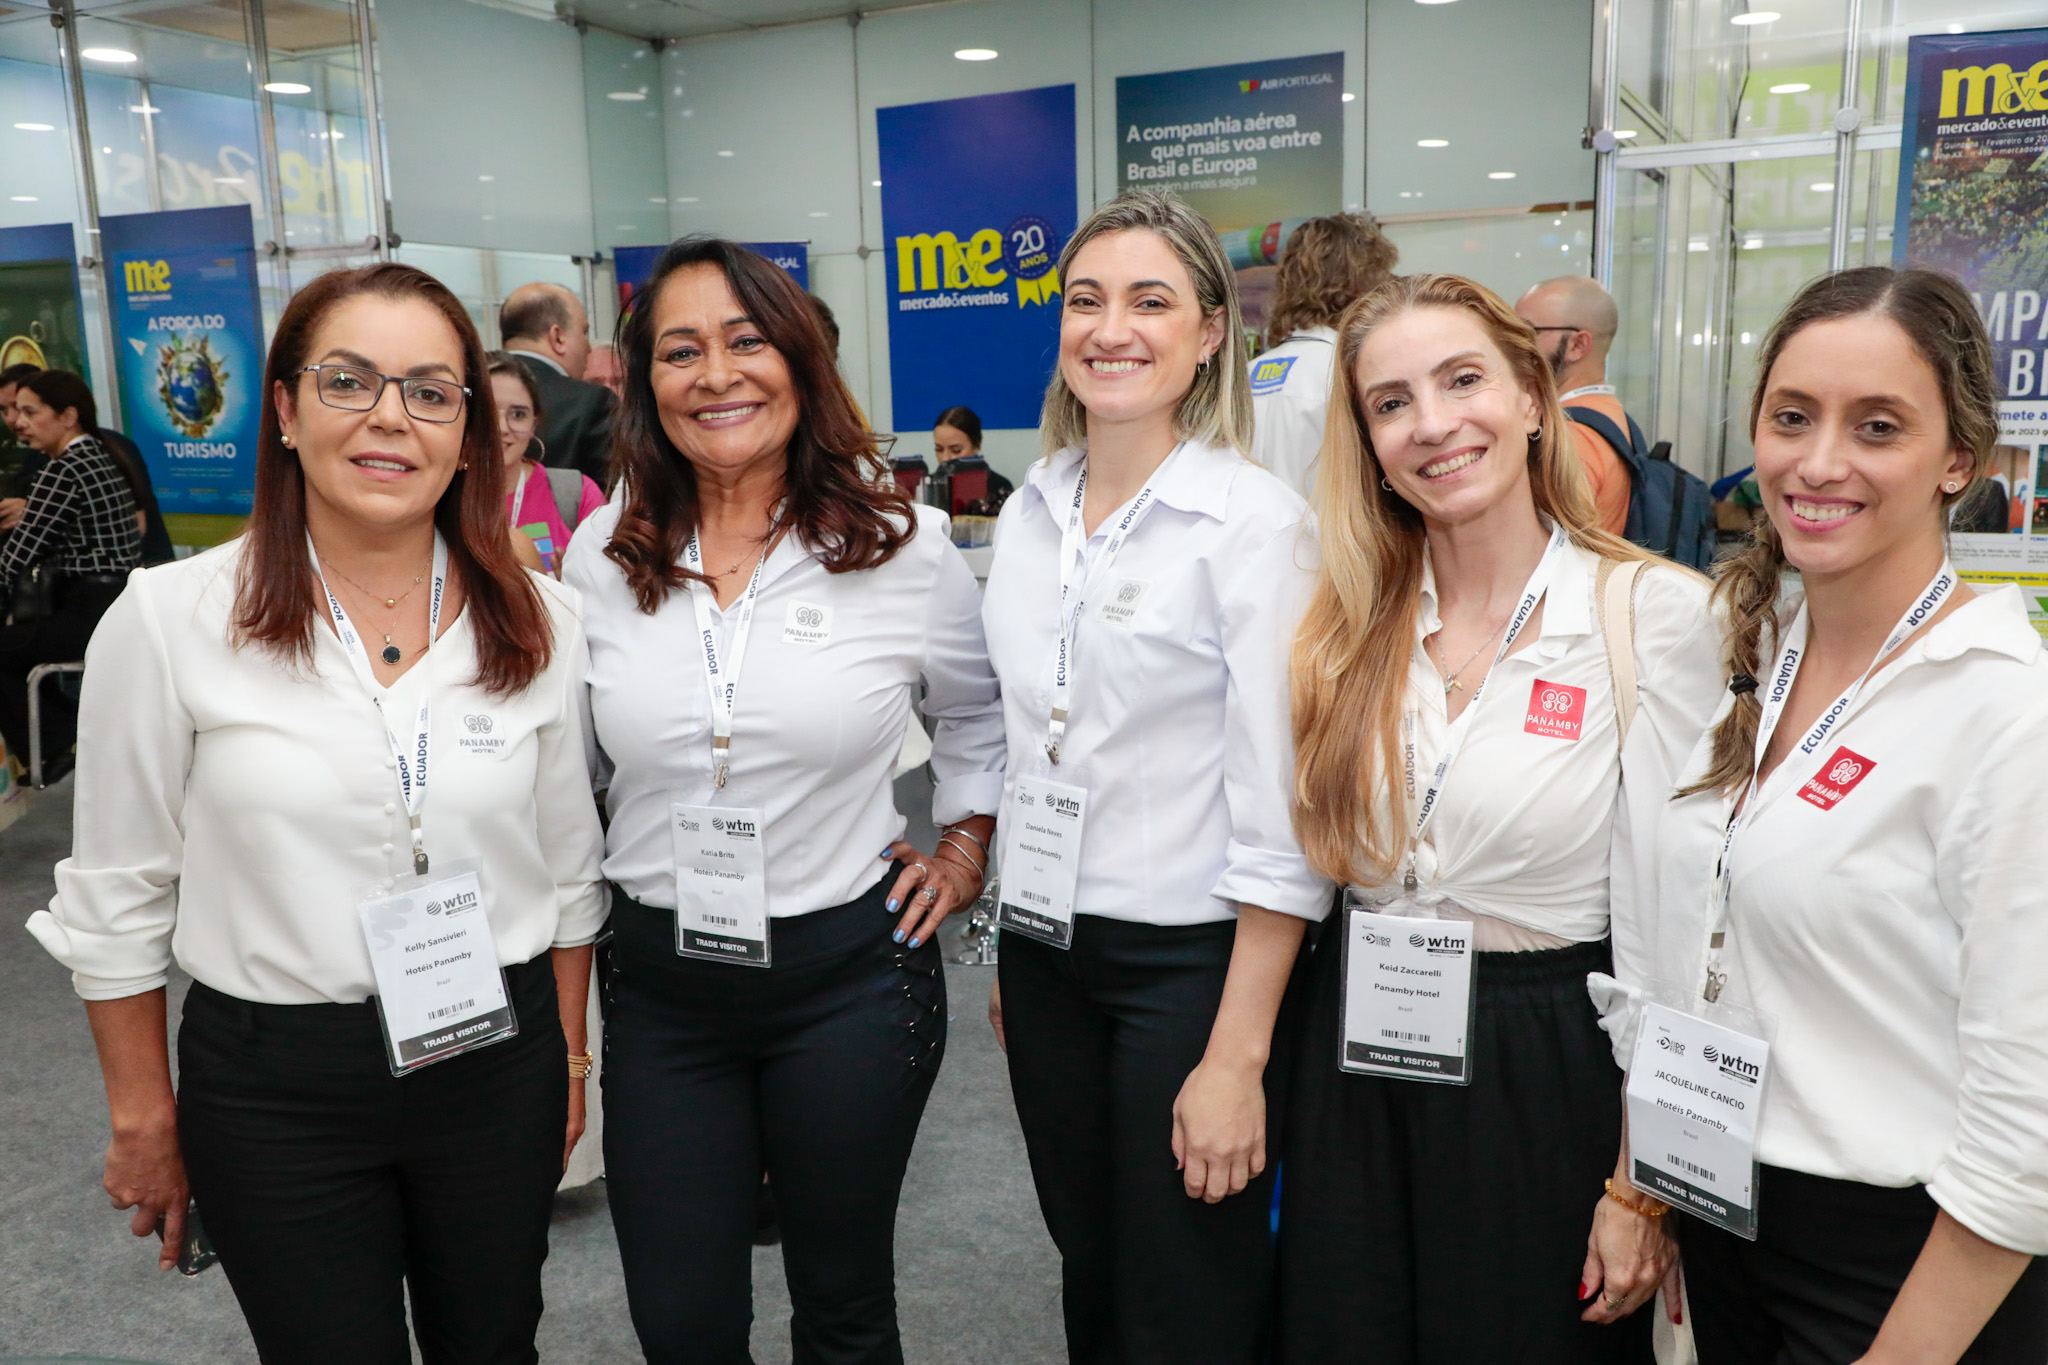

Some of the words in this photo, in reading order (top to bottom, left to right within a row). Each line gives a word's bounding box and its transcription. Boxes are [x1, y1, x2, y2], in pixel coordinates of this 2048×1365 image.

[1126, 125, 1141, 143] A
[1143, 116, 1241, 142] companhia
[1244, 112, 1297, 132] aérea
[1937, 114, 2048, 135] mercado&event
[1151, 144, 1184, 163] que
[1187, 138, 1230, 156] mais
[1232, 137, 1266, 151] voa
[1269, 130, 1322, 150] entre
[1986, 135, 2022, 147] Fevereiro
[2024, 135, 2034, 144] de
[1128, 161, 1176, 180] Brasil
[1178, 164, 1190, 176] e
[1192, 156, 1257, 176] Europa
[1183, 181, 1190, 190] a
[1191, 178, 1218, 189] mais
[1219, 176, 1257, 190] segura
[1012, 225, 1045, 258] 20
[896, 228, 1008, 292] m&e
[1019, 252, 1048, 270] ANOS
[900, 291, 1009, 311] mercado&eventos
[148, 317, 158, 331] A
[204, 314, 225, 329] DO
[2018, 428, 2040, 436] 2023
[164, 442, 237, 459] TURISMO
[1072, 469, 1087, 509] ECUADOR
[1118, 488, 1151, 531] ECUADOR
[432, 577, 443, 624] ECUADOR
[1907, 575, 1952, 627] ECUADOR
[1506, 593, 1536, 644] ECUADOR
[785, 627, 829, 640] PANAMBY
[703, 629, 719, 676] ECUADOR
[1057, 637, 1066, 686] ECUADOR
[1770, 649, 1799, 702] ECUADOR
[1527, 714, 1579, 731] PANAMBY
[1537, 727, 1564, 736] HOTEL
[1801, 698, 1849, 754] ECUADOR
[459, 739, 506, 747] PANAMBY
[416, 732, 428, 787] ECUADOR
[1405, 743, 1415, 800] ECUADOR
[1807, 779, 1843, 803] PANAMBY
[1807, 793, 1826, 805] HOTEL
[1057, 796, 1080, 812] wtm
[726, 818, 755, 832] wtm
[1025, 822, 1046, 834] Daniela
[1047, 828, 1062, 838] Neves
[718, 851, 735, 859] Brito
[1019, 843, 1037, 854] Hotéis
[1037, 847, 1062, 861] Panamby
[715, 870, 745, 881] Panamby
[443, 890, 476, 910] wtm
[1011, 912, 1030, 926] TRADE
[1031, 918, 1054, 933] VISITOR
[405, 941, 426, 954] Kelly
[428, 929, 467, 947] Sansivieri
[695, 937, 718, 949] TRADE
[720, 941, 748, 953] VISITOR
[1428, 936, 1465, 948] wtm
[405, 960, 433, 976] Hotéis
[434, 951, 472, 968] Panamby
[1380, 964, 1398, 972] Keid
[1400, 966, 1441, 977] Zaccarelli
[436, 977, 451, 986] Brazil
[1375, 983, 1414, 996] Panamby
[1416, 989, 1440, 998] Hotel
[423, 1032, 455, 1049] TRADE
[456, 1020, 491, 1038] VISITOR
[1675, 1042, 1685, 1050] DO
[1369, 1052, 1400, 1062] TRADE
[1403, 1057, 1440, 1068] VISITOR
[1721, 1053, 1759, 1077] wtm
[1655, 1070, 1709, 1097] JACQUELINE
[1711, 1090, 1745, 1110] CANCIO
[1656, 1098, 1684, 1115] Hotéis
[1686, 1108, 1728, 1133] Panamby
[1684, 1129, 1698, 1141] Brazil
[1656, 1177, 1687, 1197] TRADE
[1689, 1191, 1727, 1216] VISITOR
